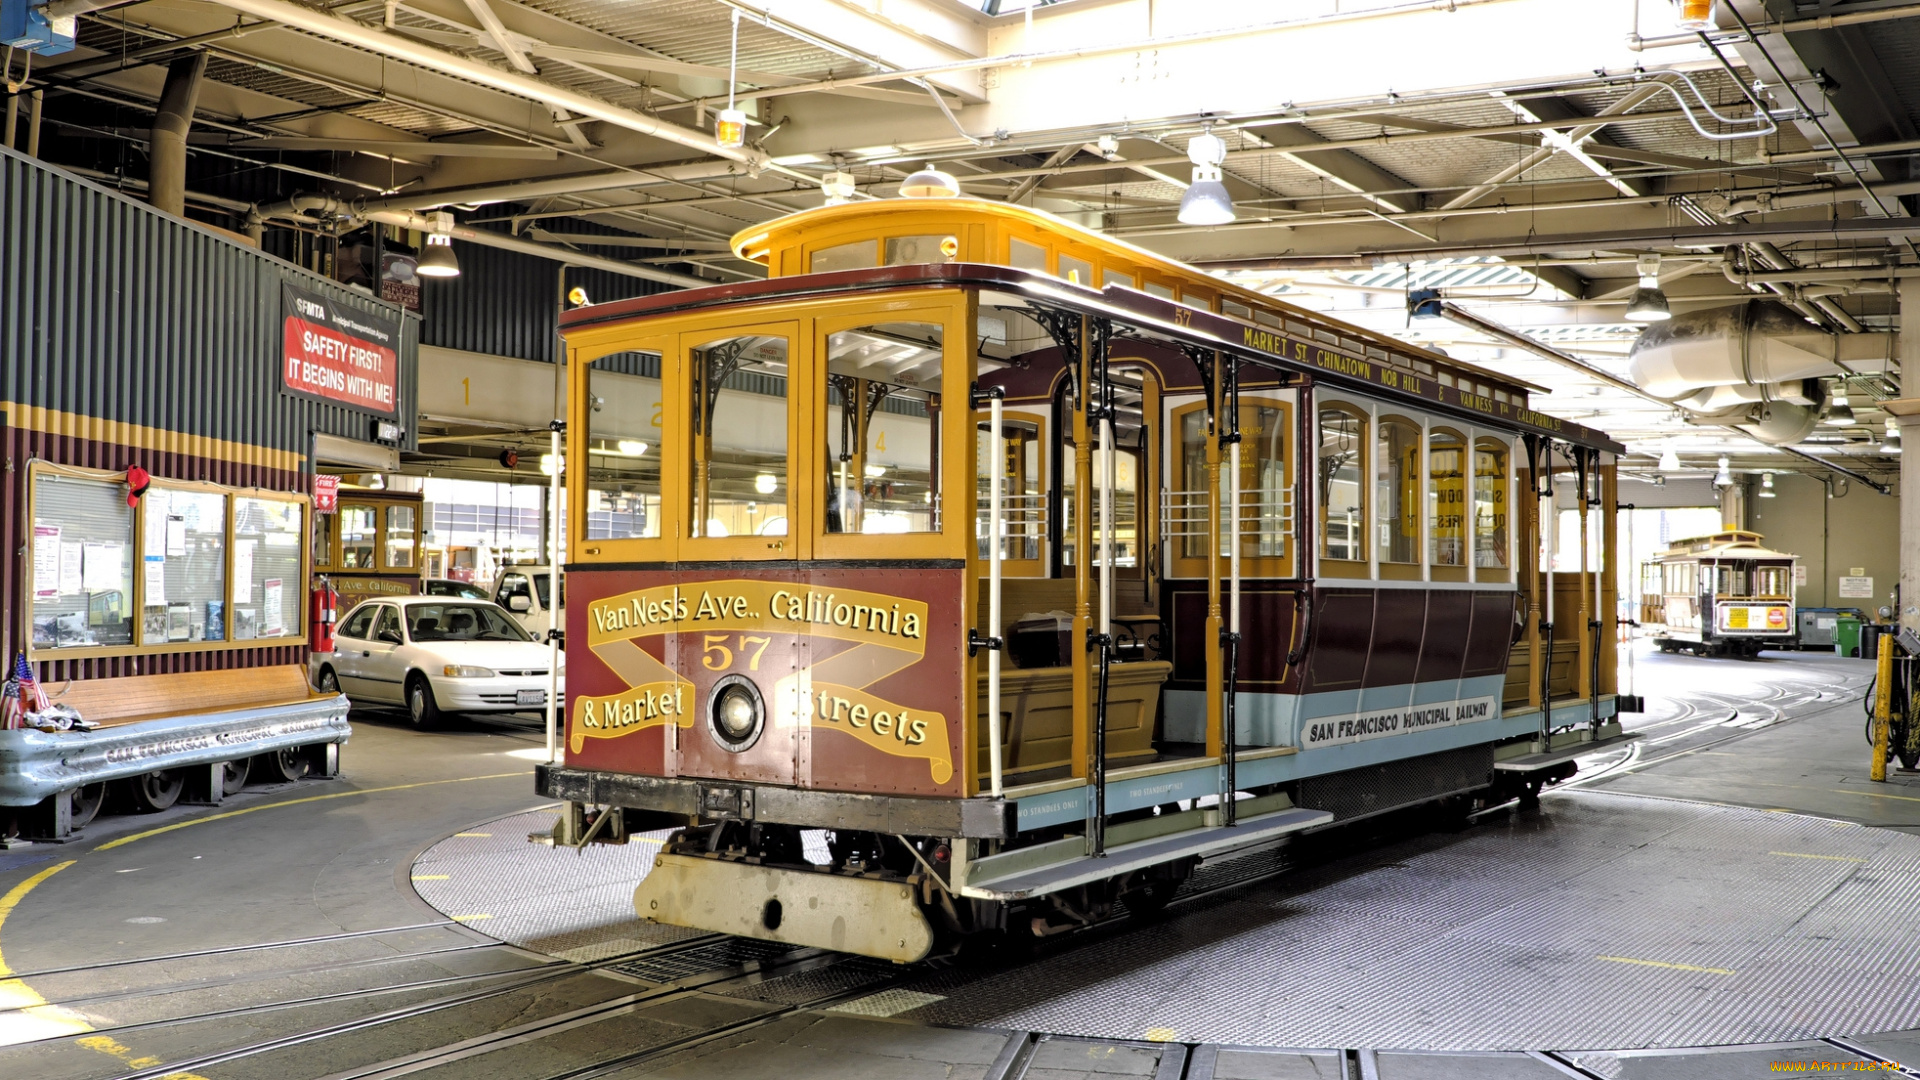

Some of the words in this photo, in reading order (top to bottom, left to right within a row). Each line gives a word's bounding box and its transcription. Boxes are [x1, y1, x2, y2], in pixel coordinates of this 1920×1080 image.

[296, 298, 325, 320] SFMTA
[1175, 306, 1192, 328] 57
[375, 329, 389, 342] Agency
[303, 330, 348, 362] SAFETY
[349, 345, 382, 373] FIRST!
[759, 347, 778, 356] DANGER
[289, 357, 301, 380] IT
[302, 361, 345, 392] BEGINS
[346, 374, 373, 399] WITH
[375, 382, 393, 404] ME!
[1243, 327, 1288, 357] MARKET
[1316, 349, 1371, 380] CHINATOWN
[1381, 368, 1398, 387] NOB
[1402, 374, 1421, 395] HILL
[1438, 385, 1444, 402] &
[1460, 390, 1474, 408] VAN
[1474, 396, 1493, 414] NESS
[1516, 408, 1553, 431] CALIFORNIA
[462, 377, 470, 405] 1
[875, 431, 887, 453] 4
[1581, 427, 1589, 440] 57
[1120, 462, 1129, 481] 6
[318, 479, 334, 488] FIRE
[368, 580, 410, 595] California
[593, 604, 629, 634] Van
[631, 596, 688, 627] Ness
[770, 589, 921, 639] California
[702, 634, 772, 671] 57
[583, 700, 599, 728] &
[602, 687, 683, 729] Market
[1309, 722, 1335, 743] SAN
[1337, 713, 1398, 738] FRANCISCO
[1402, 707, 1450, 729] MUNICIPAL
[1455, 702, 1489, 721] RAILWAY
[106, 747, 136, 763] SAN
[139, 735, 209, 758] FRANCISCO
[216, 726, 276, 747] MUNICIPAL
[1129, 790, 1142, 798] TWO
[1030, 804, 1061, 815] STANDEES
[1062, 800, 1078, 810] ONLY
